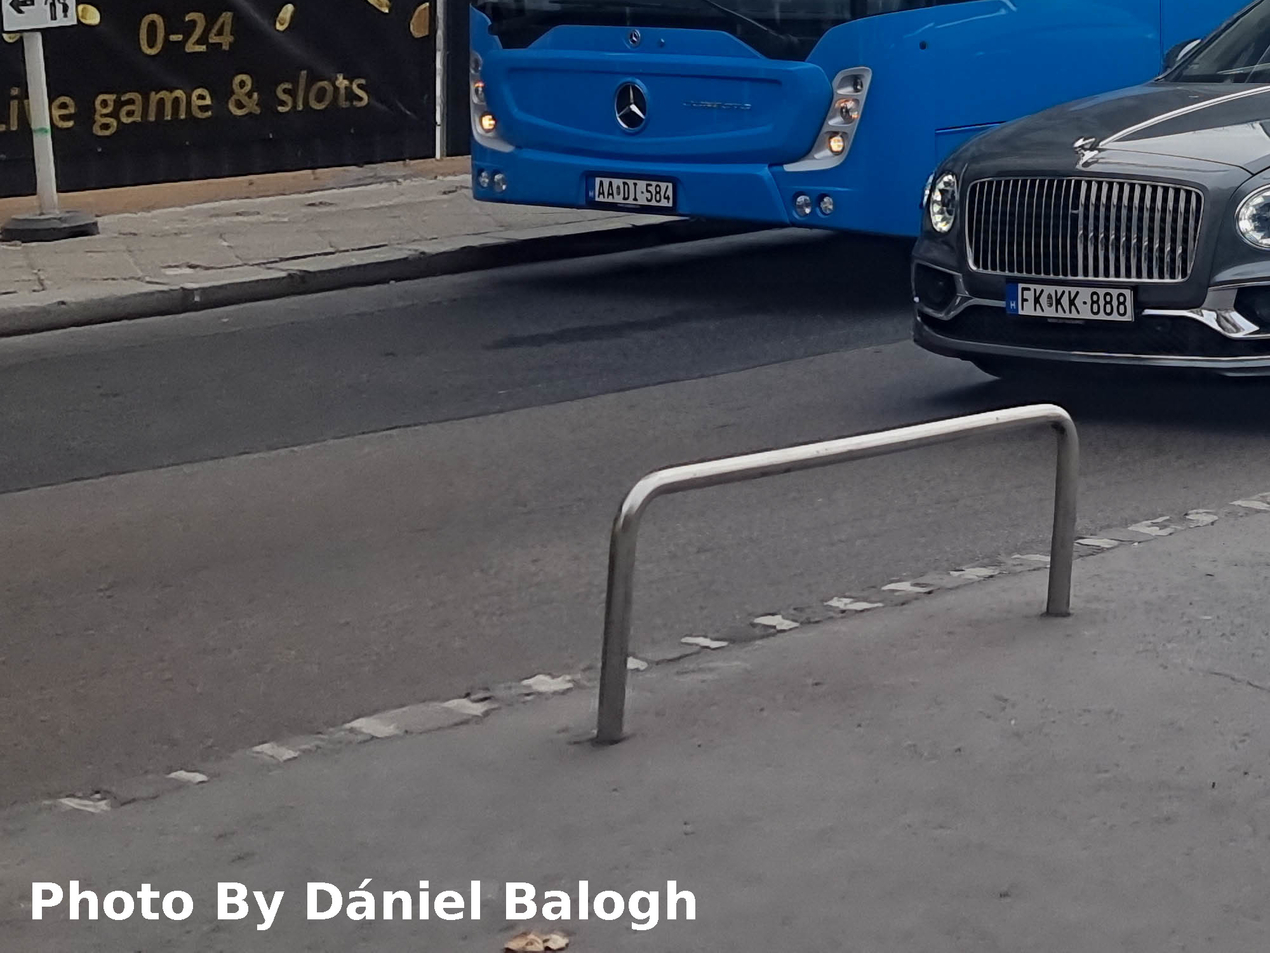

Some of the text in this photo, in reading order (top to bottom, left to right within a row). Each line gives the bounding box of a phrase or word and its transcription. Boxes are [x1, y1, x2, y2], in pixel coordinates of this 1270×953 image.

[139, 11, 235, 56] 0-24
[0, 70, 370, 136] ie game & slots
